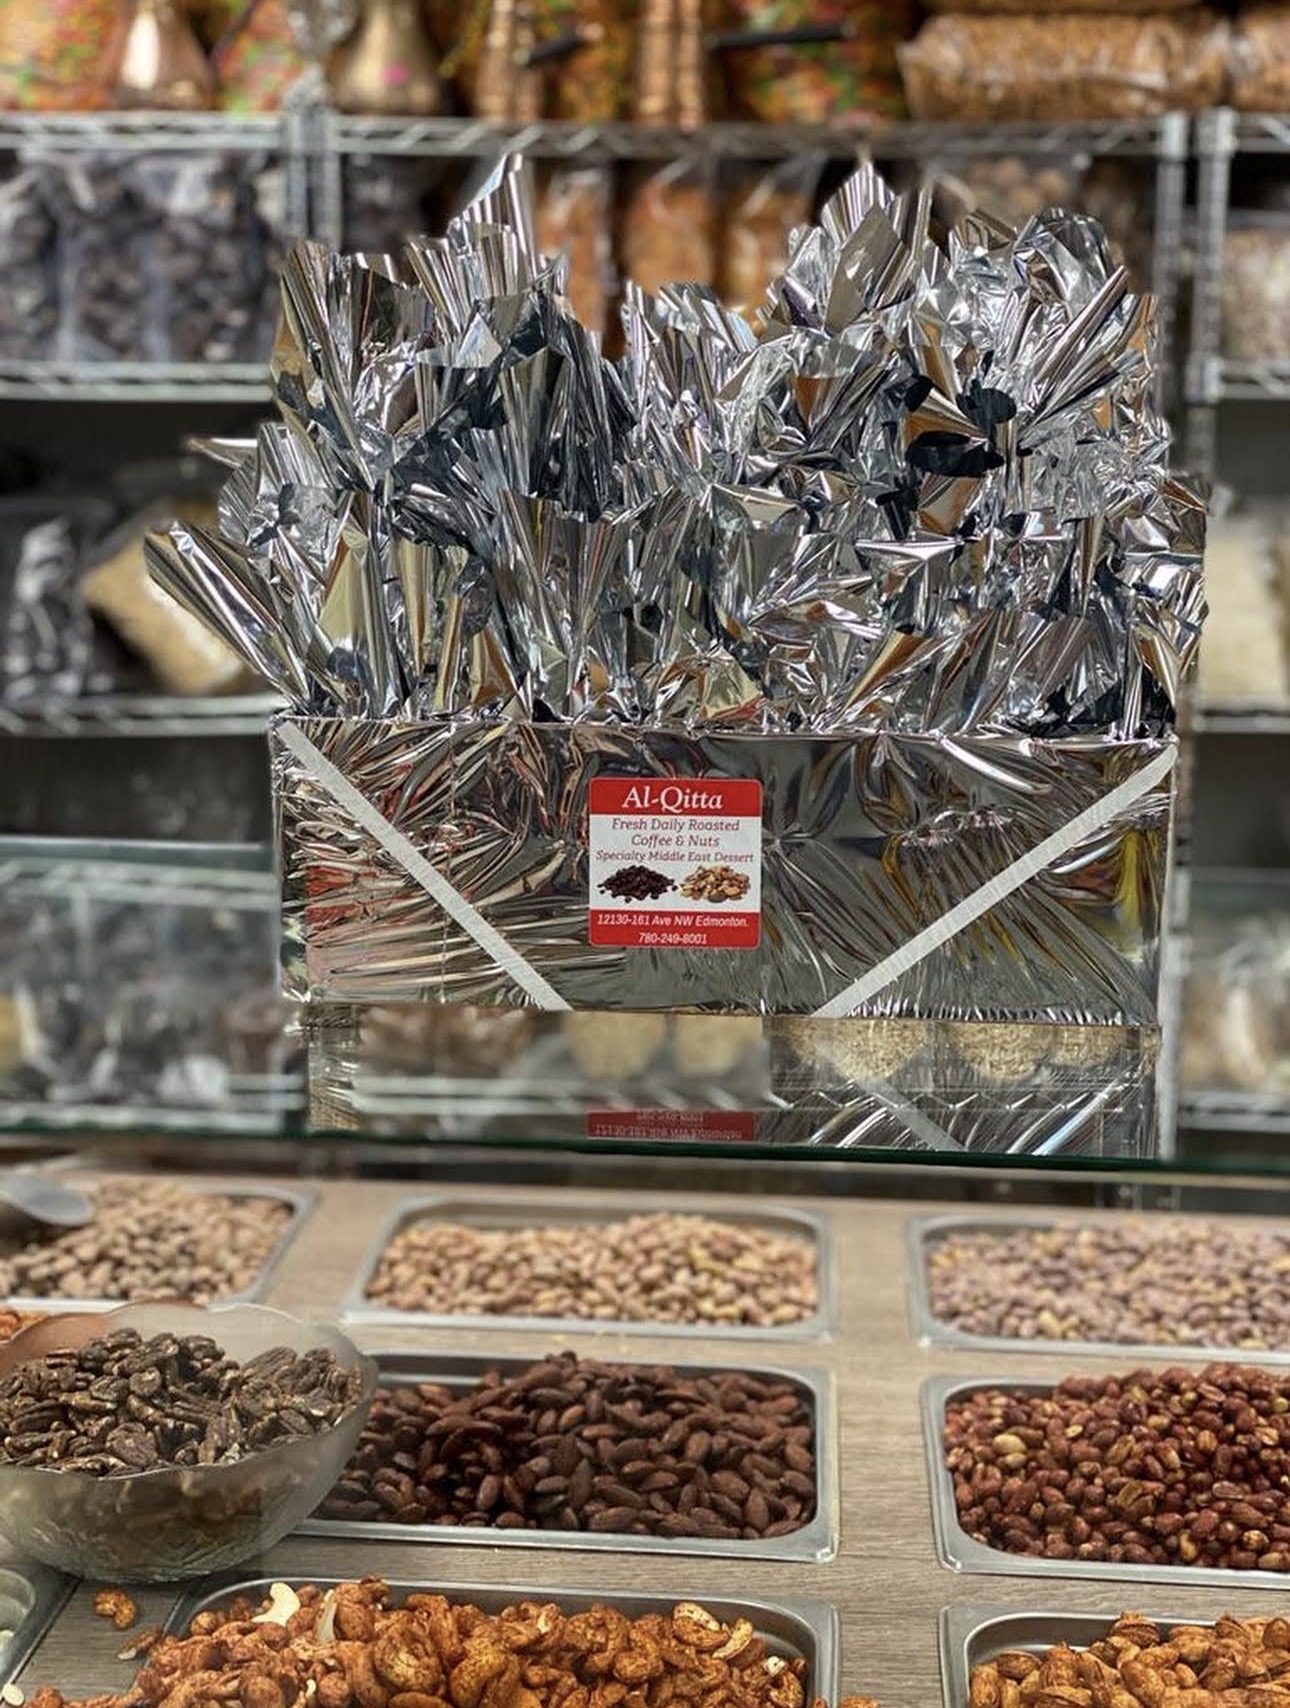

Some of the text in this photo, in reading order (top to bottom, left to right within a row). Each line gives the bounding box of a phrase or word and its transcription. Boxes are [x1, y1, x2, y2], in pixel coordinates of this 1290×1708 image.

[621, 785, 724, 813] Al-Qitta
[611, 818, 740, 832] Fresh Daily Roasted
[631, 834, 720, 848] Coffee & Nuts
[596, 850, 754, 863] Specialty Middle East Dessert
[597, 914, 650, 925] 12130-161
[651, 915, 671, 926] Ave
[673, 915, 694, 926] NW
[638, 932, 707, 944] 780-249-8001
